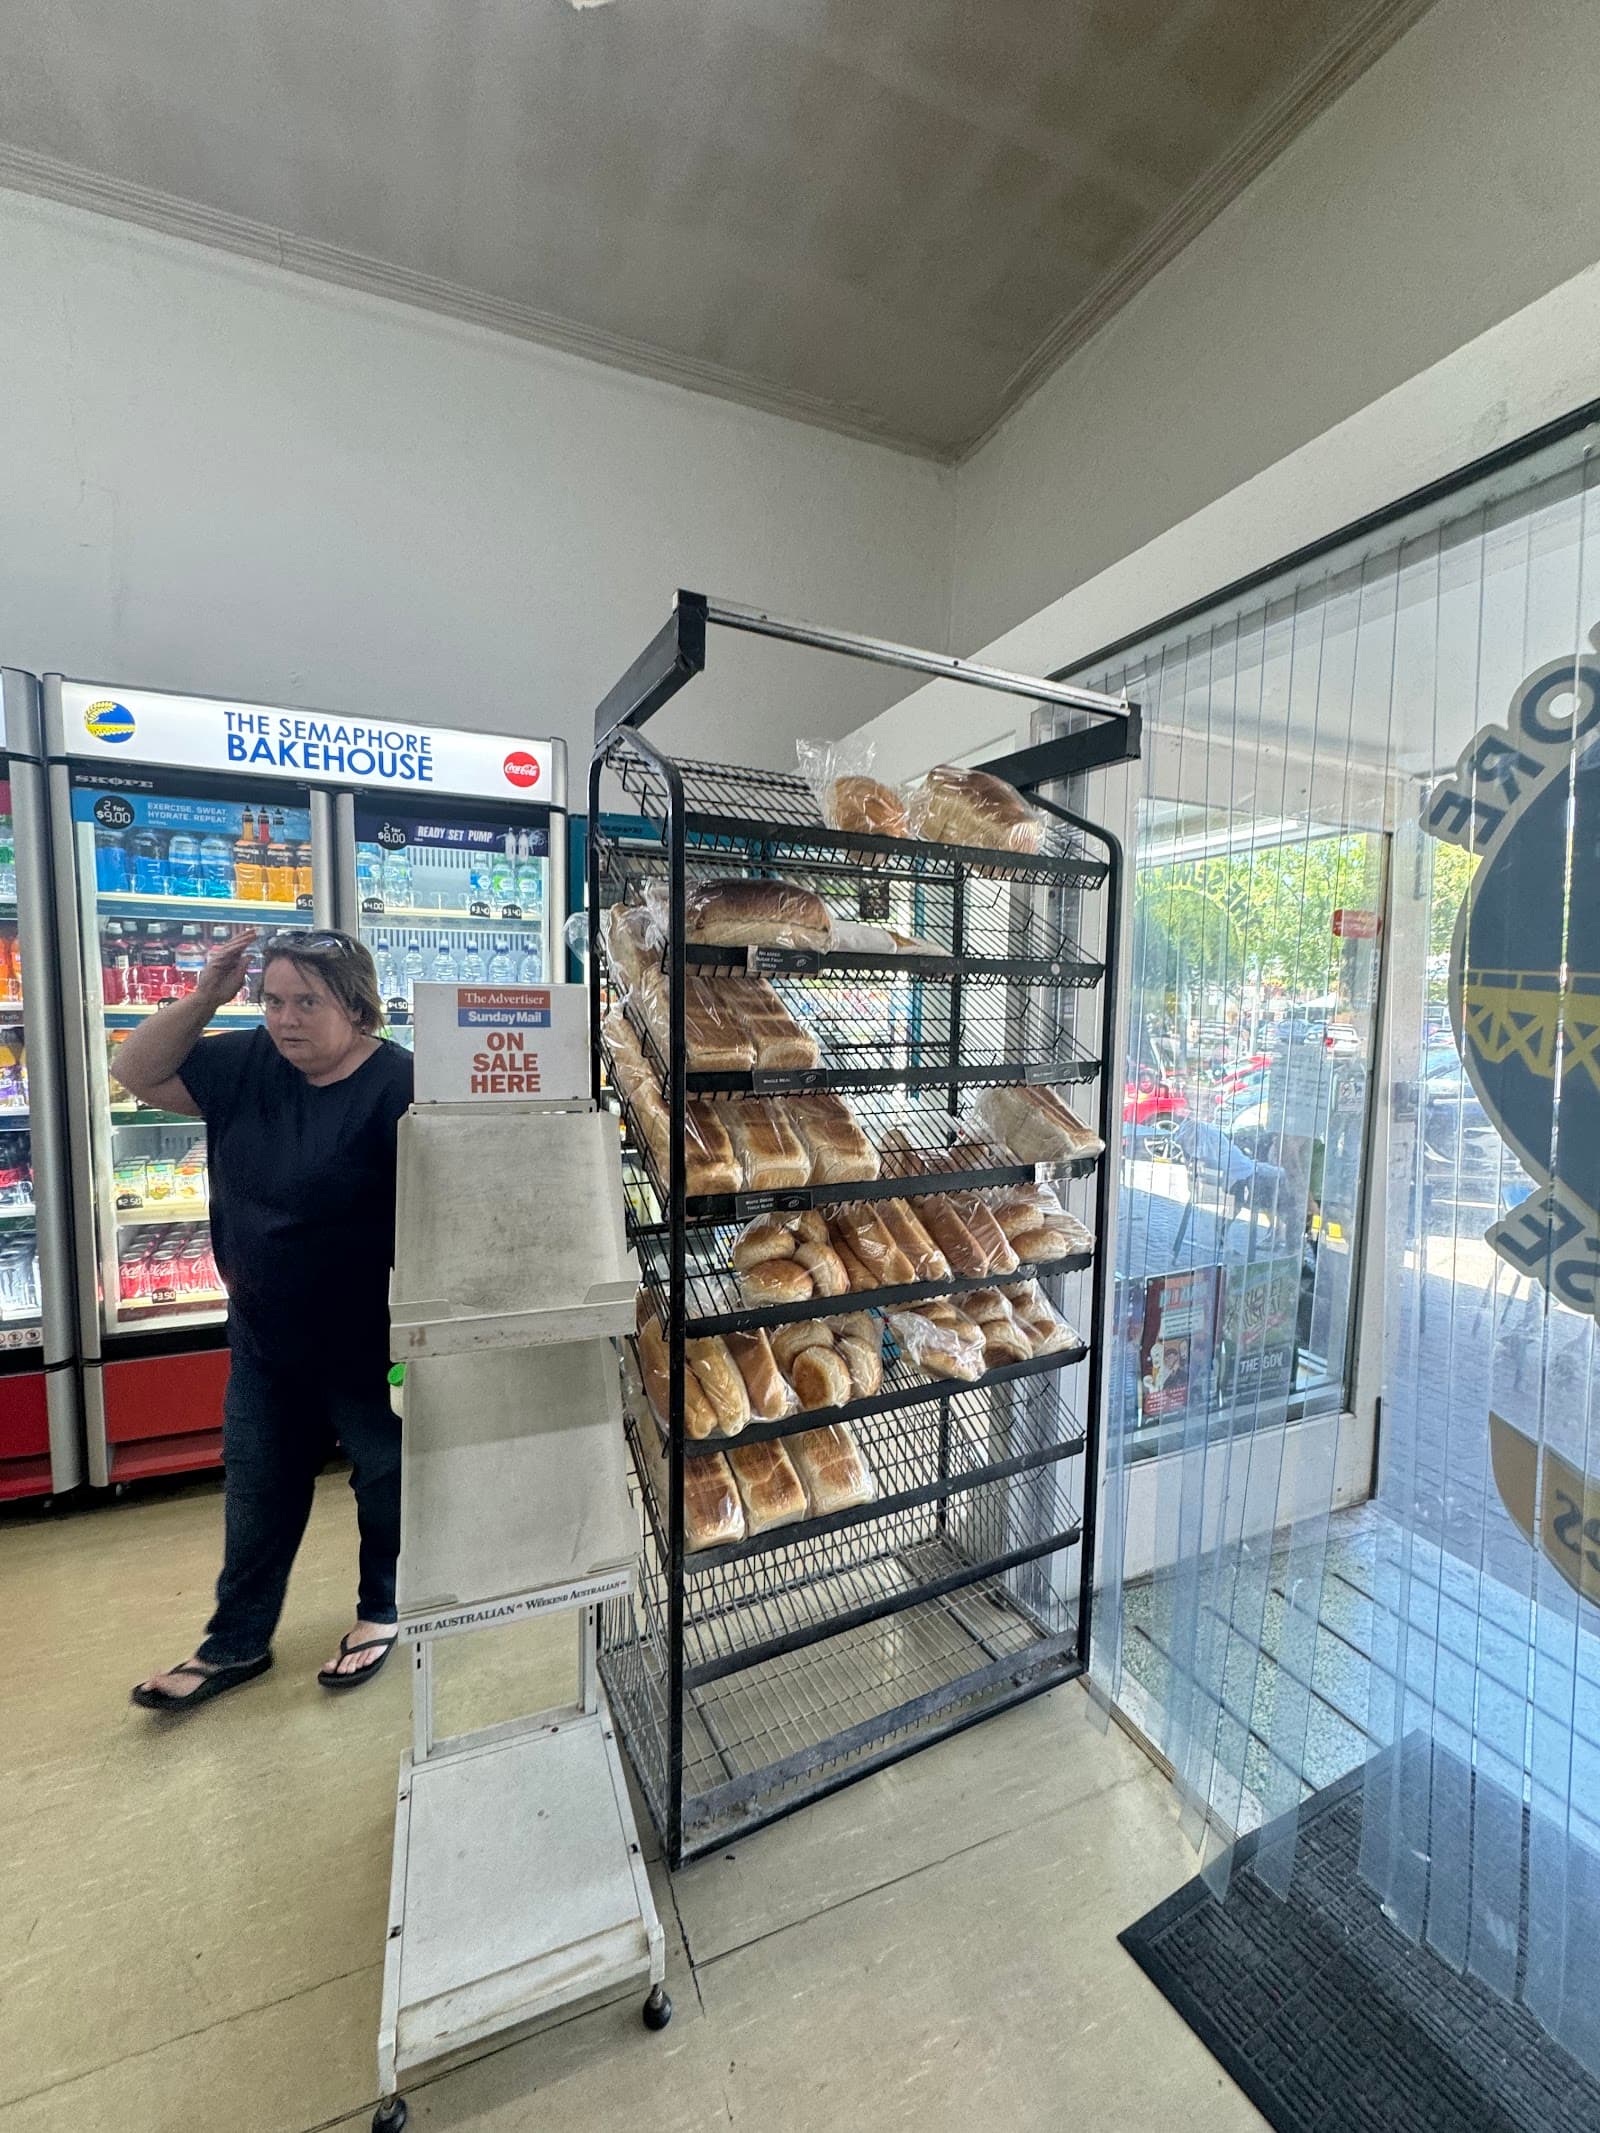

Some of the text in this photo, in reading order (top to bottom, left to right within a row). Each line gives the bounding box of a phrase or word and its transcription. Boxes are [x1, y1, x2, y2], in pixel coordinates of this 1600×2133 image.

[224, 711, 431, 754] THE SEMAPHORE
[227, 733, 433, 782] BAKEHOUSE
[504, 762, 538, 777] Coca-Cola
[75, 774, 154, 789] SKOPE
[103, 800, 125, 813] 2 for
[147, 802, 195, 814] EXERCISE.
[96, 810, 131, 824] $9.00
[383, 822, 390, 833] 2
[417, 825, 493, 843] READY SET PUMP
[377, 831, 406, 844] $8.00
[465, 992, 544, 1005] The Advertiser
[468, 1010, 542, 1025] Sunday Mail
[486, 1032, 524, 1051] ON
[473, 1053, 538, 1072] SALE
[471, 1074, 541, 1093] HERE
[152, 1292, 176, 1301] $3.50
[1240, 1351, 1284, 1374] THE GOV
[405, 1581, 621, 1636] THE AUSTRALIAN WEEKEND AUSTRALIAN
